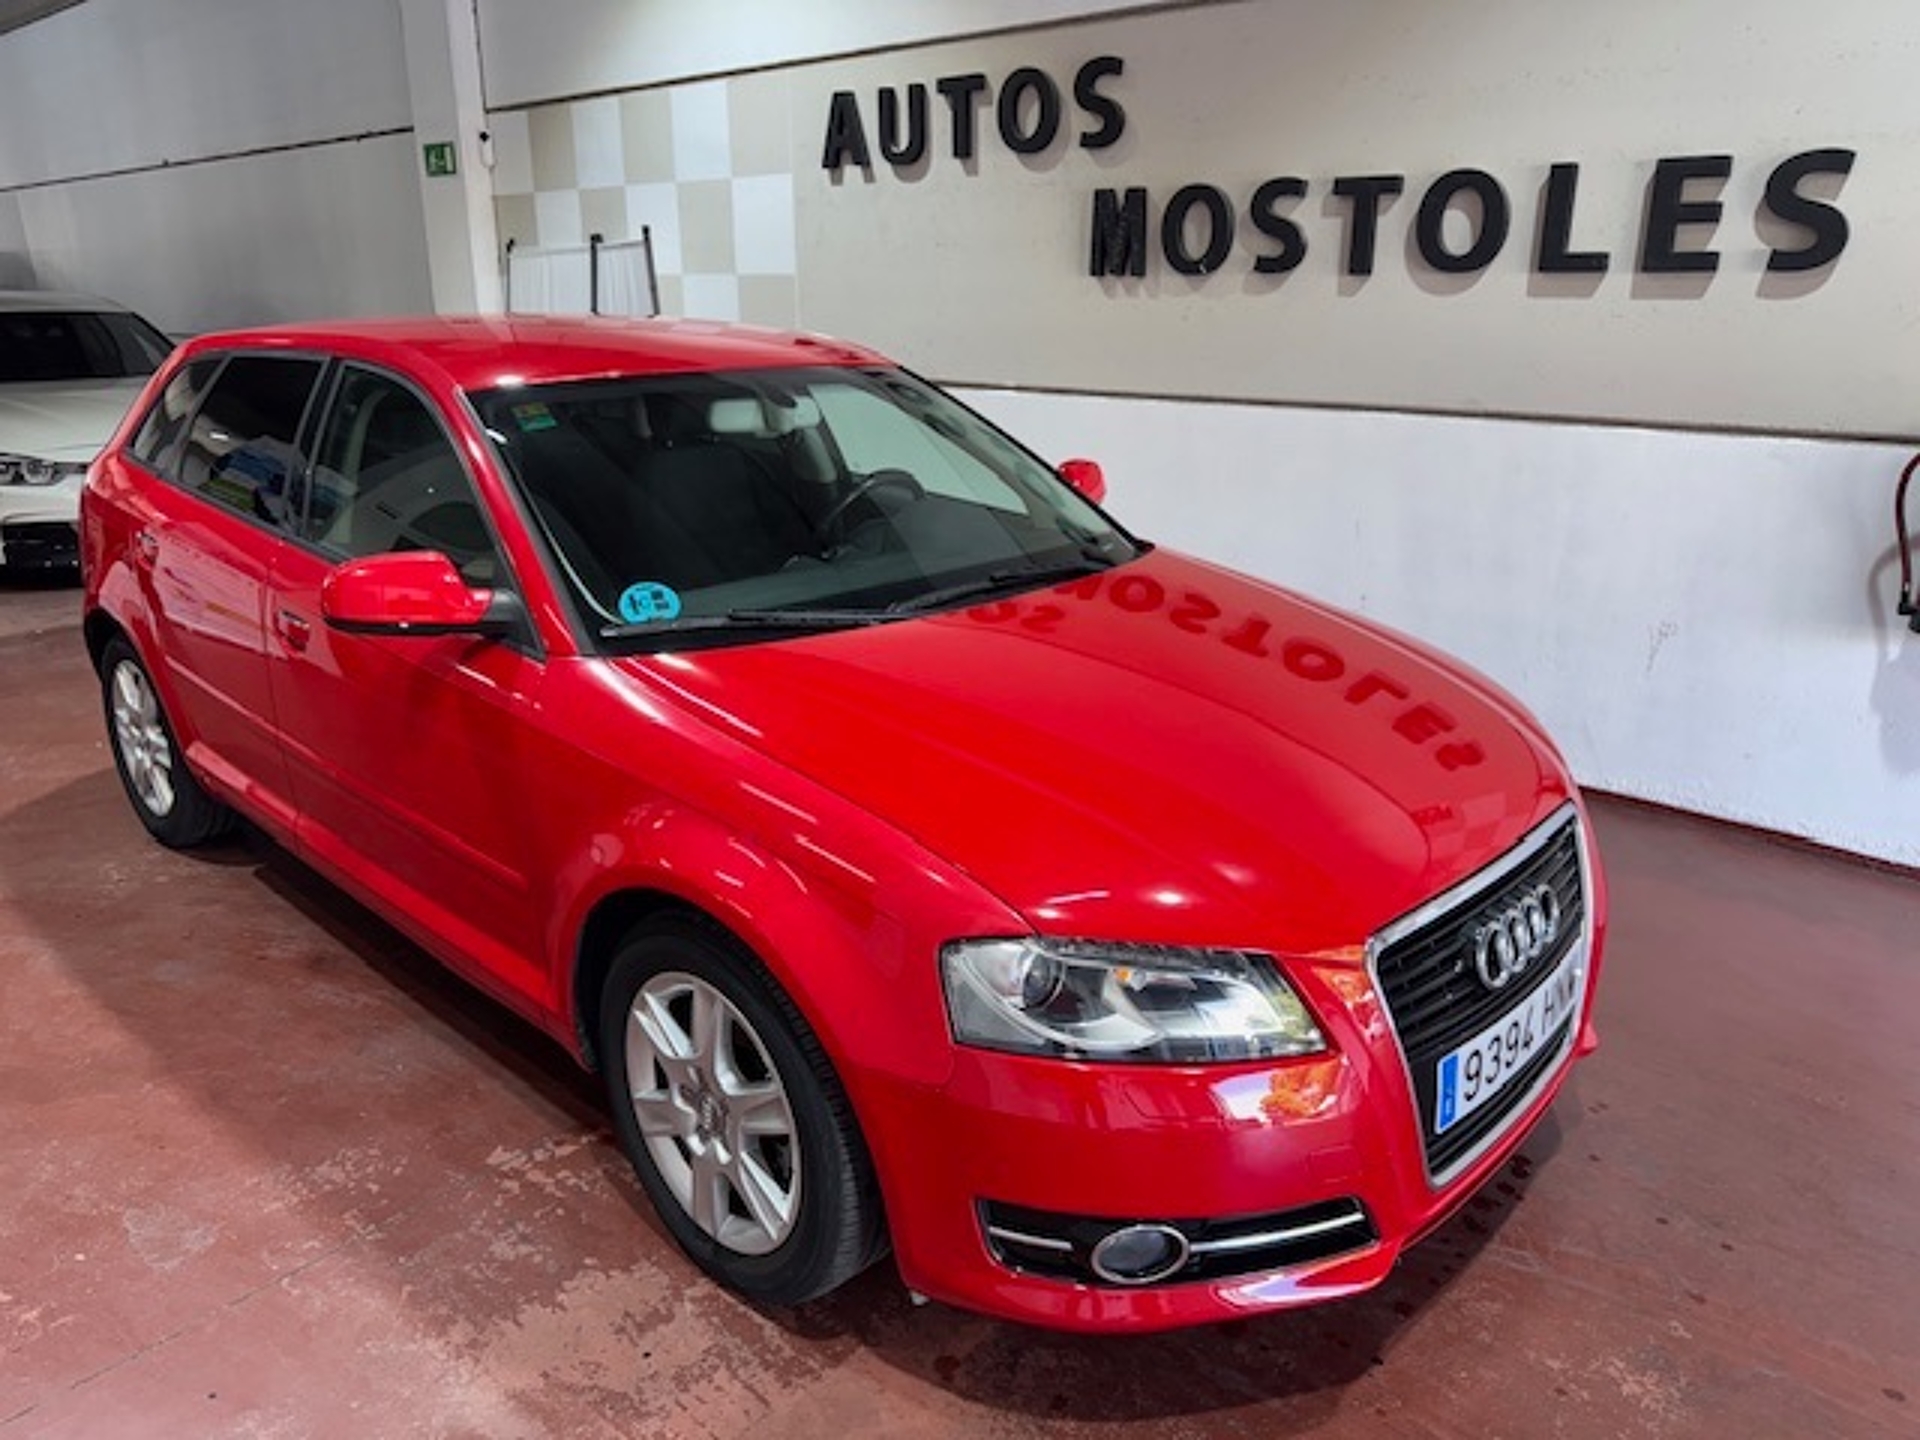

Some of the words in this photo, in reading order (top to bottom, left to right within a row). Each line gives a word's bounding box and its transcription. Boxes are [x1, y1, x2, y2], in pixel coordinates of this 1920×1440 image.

[823, 56, 1126, 174] AUTOS
[1090, 150, 1856, 278] MOSTOLES
[1464, 1004, 1534, 1101] 9394
